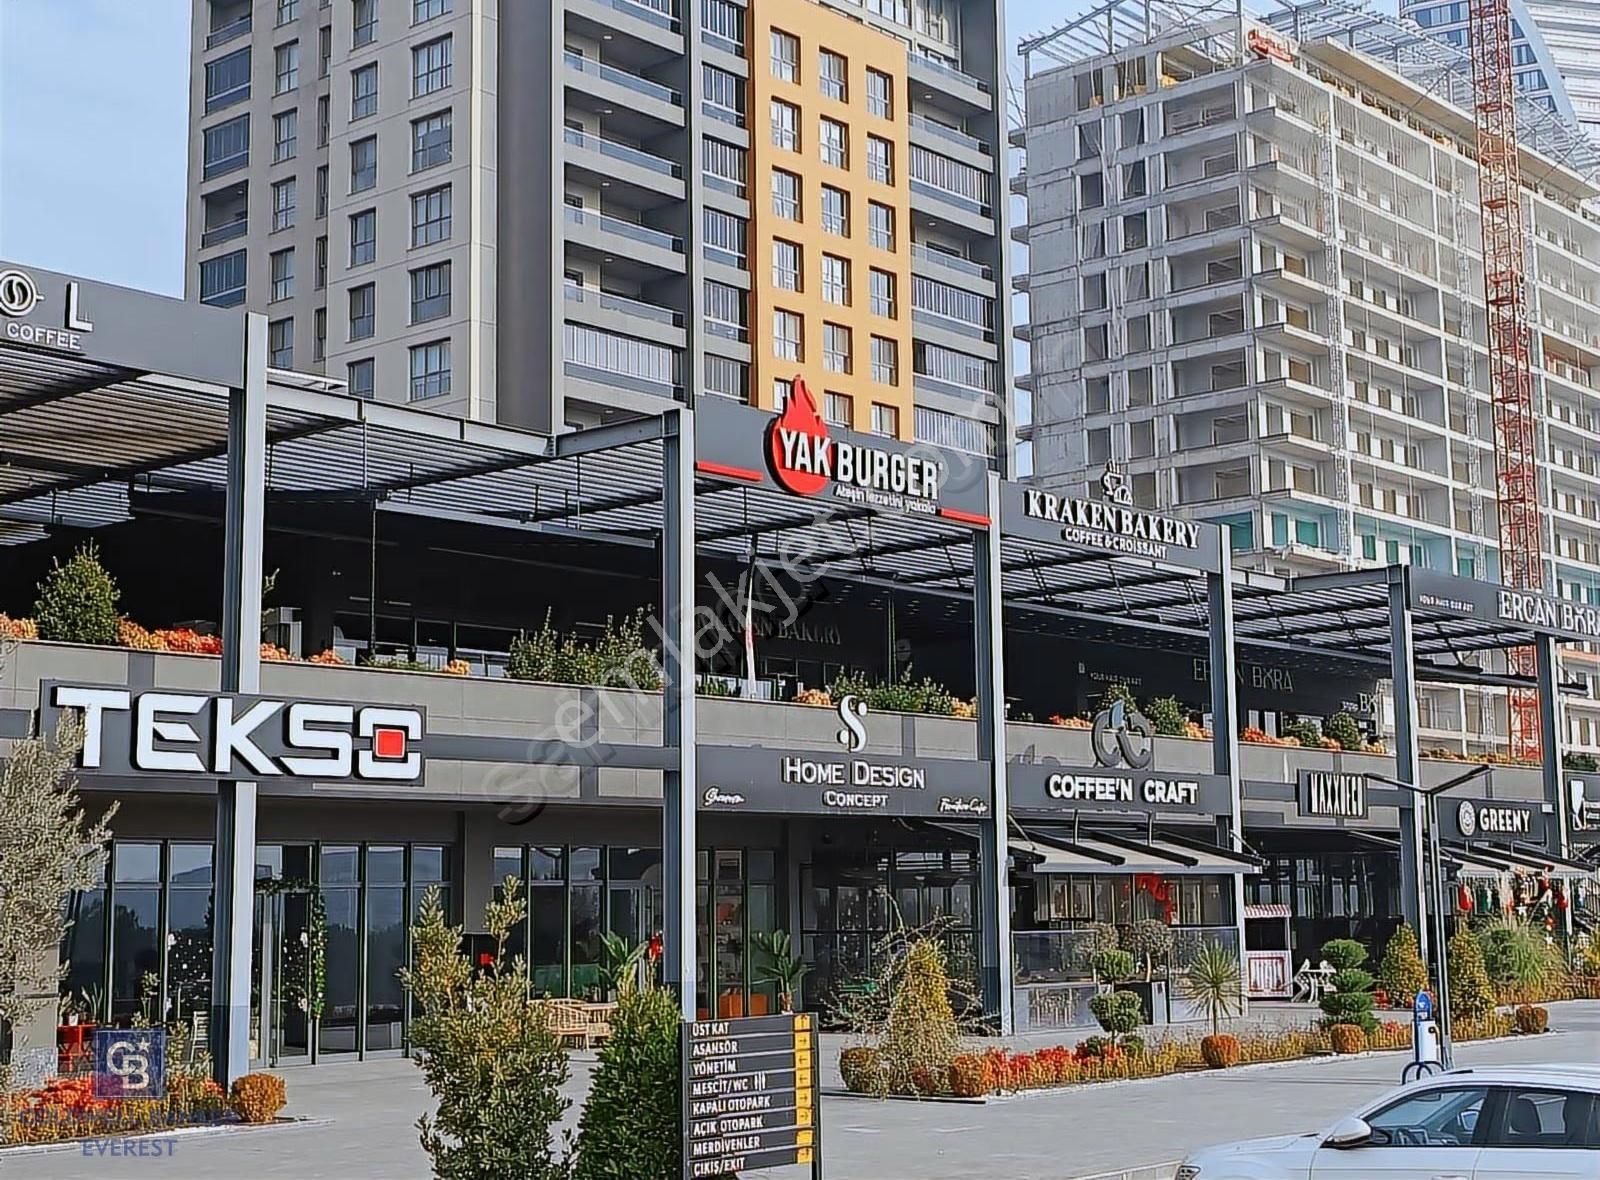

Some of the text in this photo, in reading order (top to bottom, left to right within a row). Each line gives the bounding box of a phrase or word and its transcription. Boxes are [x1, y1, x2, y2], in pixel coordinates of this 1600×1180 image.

[6, 322, 82, 350] COFFEE
[779, 427, 939, 500] YAK BURGER
[1026, 488, 1201, 549] KRAKEN BAKERY
[1064, 527, 1104, 547] COFFEE
[1498, 590, 1557, 628] ERCAN
[55, 685, 423, 781] TEKSO
[824, 790, 889, 808] CONCEPT
[1048, 774, 1200, 804] COFFEE'N CRAFT
[1479, 807, 1531, 833] GREENY
[711, 1021, 730, 1035] KAT
[692, 1096, 771, 1115] KAPALI OTOPARK
[693, 1116, 764, 1137] AÇIK OTOPARK
